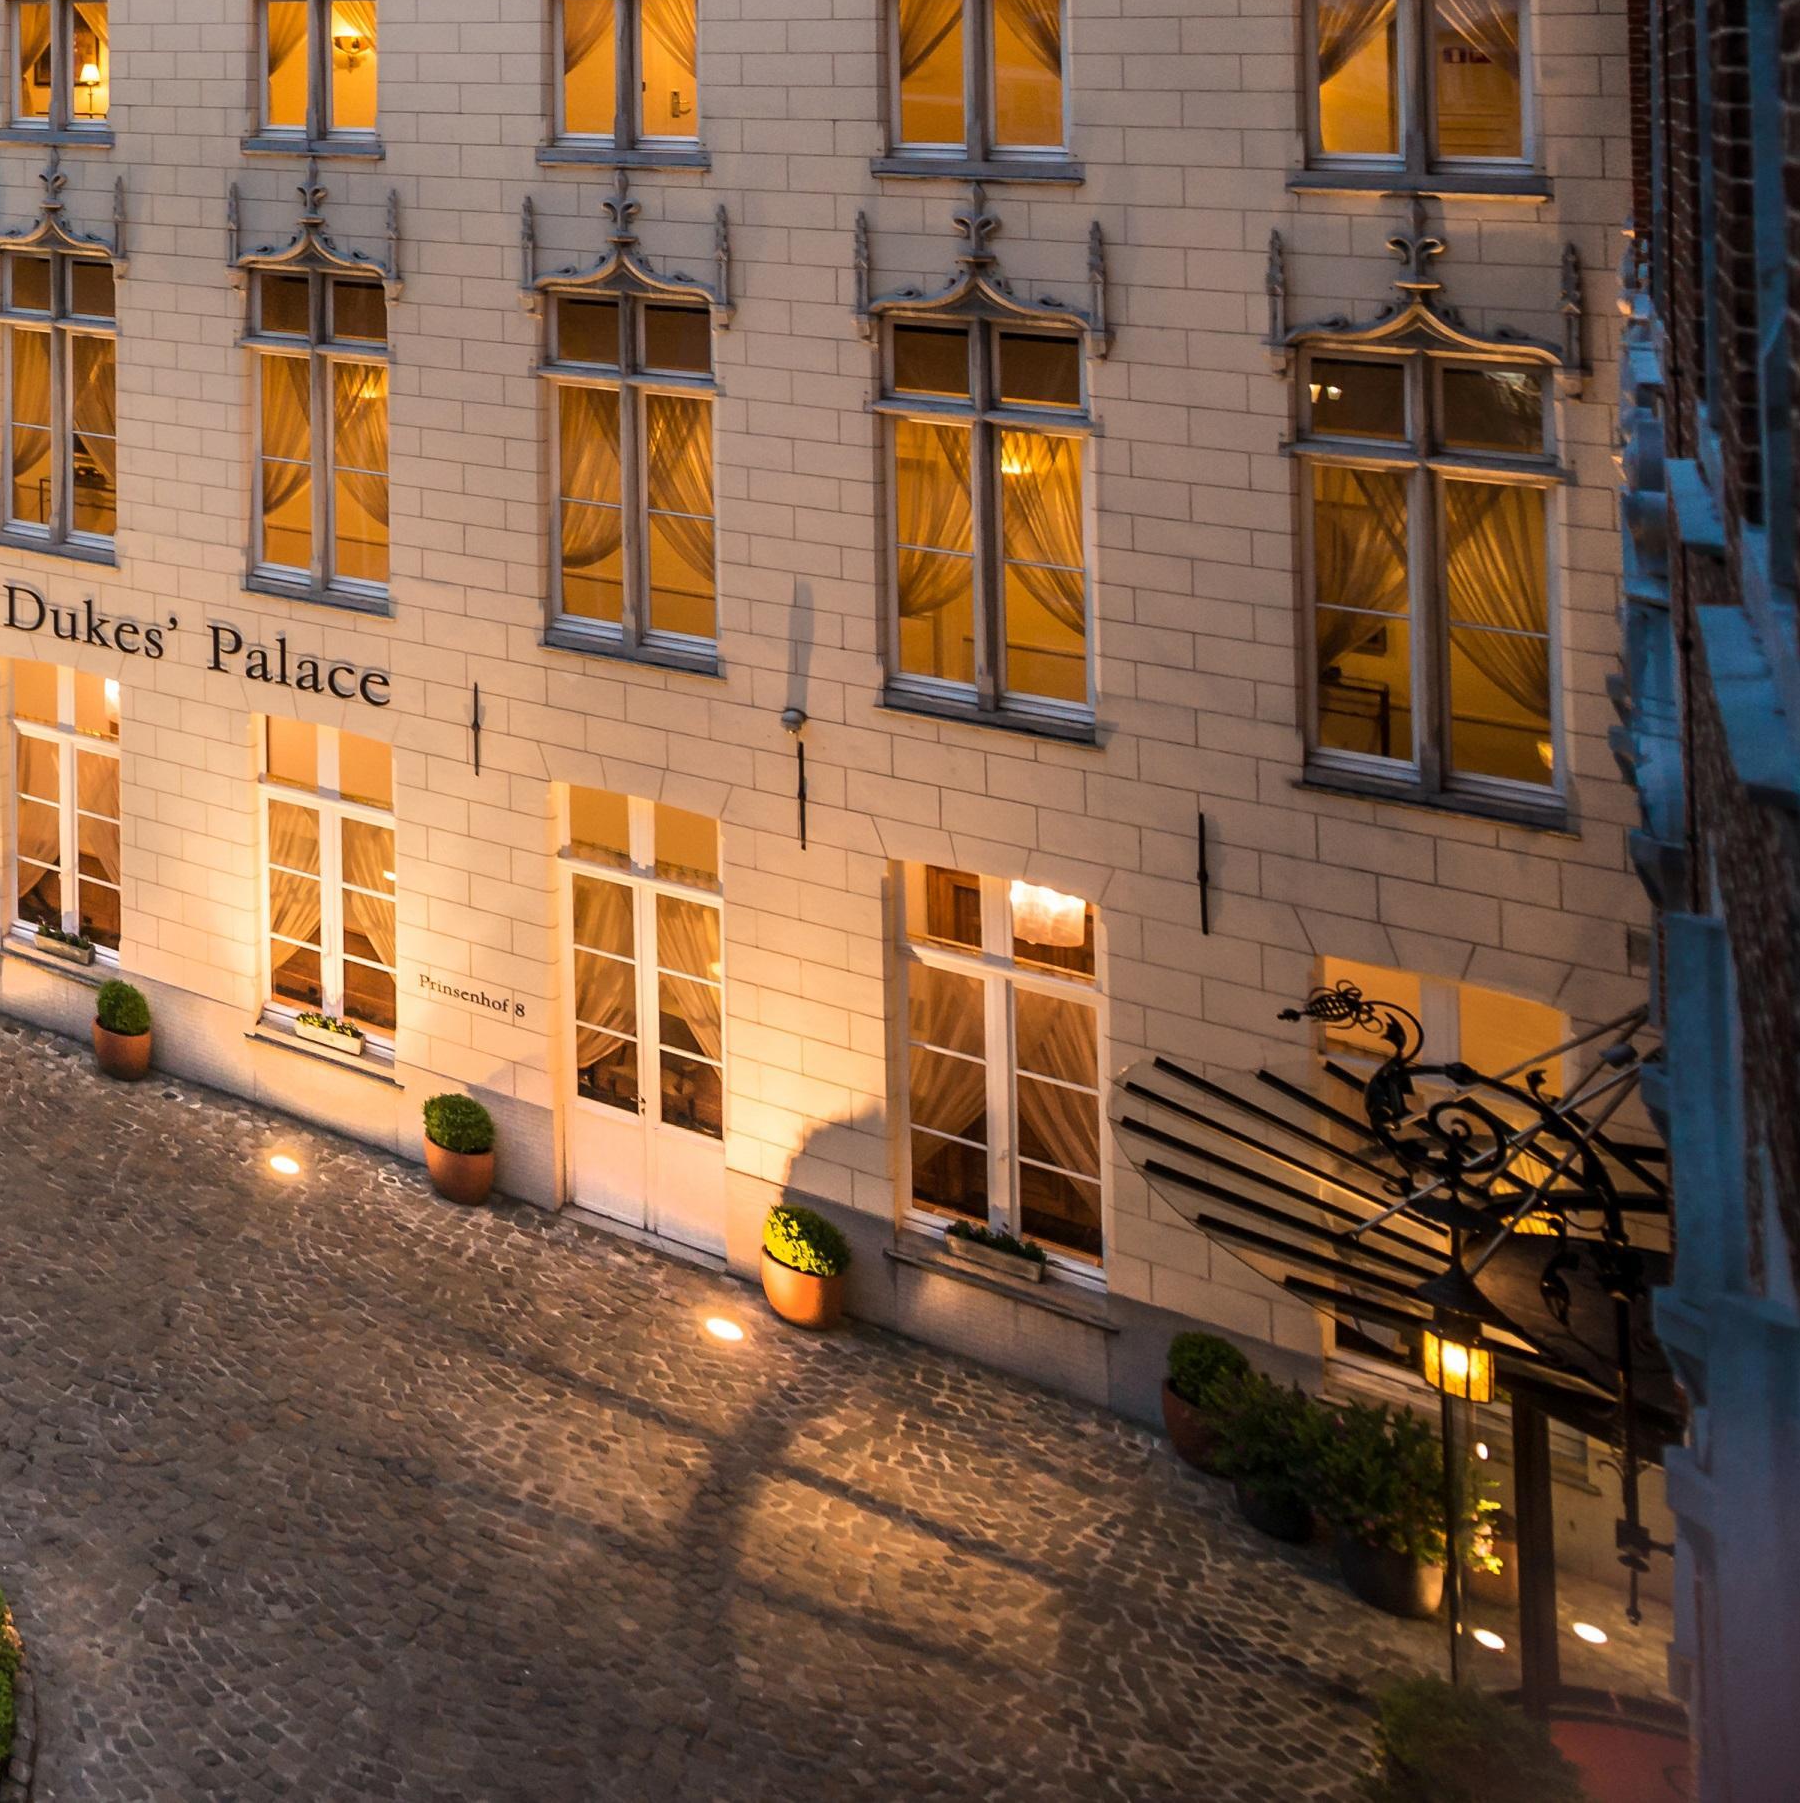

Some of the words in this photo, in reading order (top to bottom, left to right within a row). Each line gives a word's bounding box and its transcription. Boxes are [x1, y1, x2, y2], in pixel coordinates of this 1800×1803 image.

[3, 584, 178, 659] Dukes’
[206, 625, 391, 706] Palace
[419, 974, 509, 1013] Prinsenhof
[514, 1003, 526, 1017] 8
